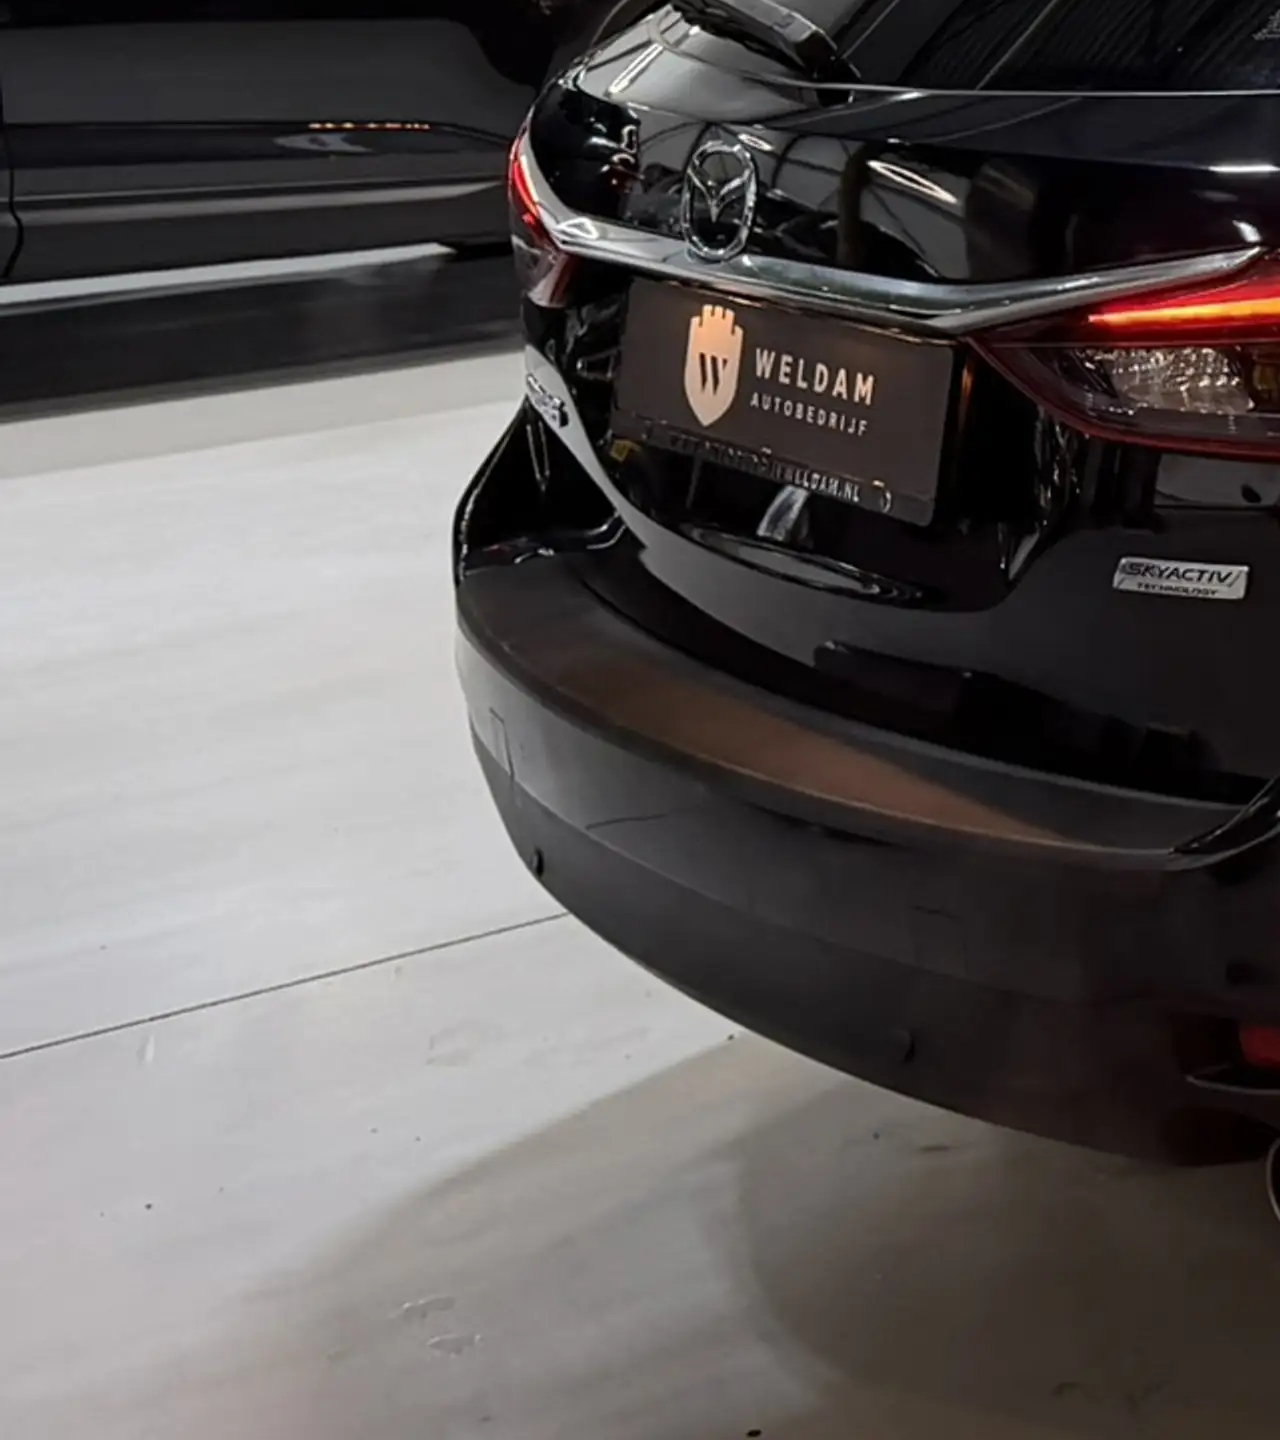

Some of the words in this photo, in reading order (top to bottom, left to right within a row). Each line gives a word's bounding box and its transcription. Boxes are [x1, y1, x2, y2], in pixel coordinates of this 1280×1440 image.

[754, 346, 876, 406] WELDAM
[749, 390, 869, 437] AUTOBEDRIJF
[1120, 561, 1234, 584] SKYACTIV
